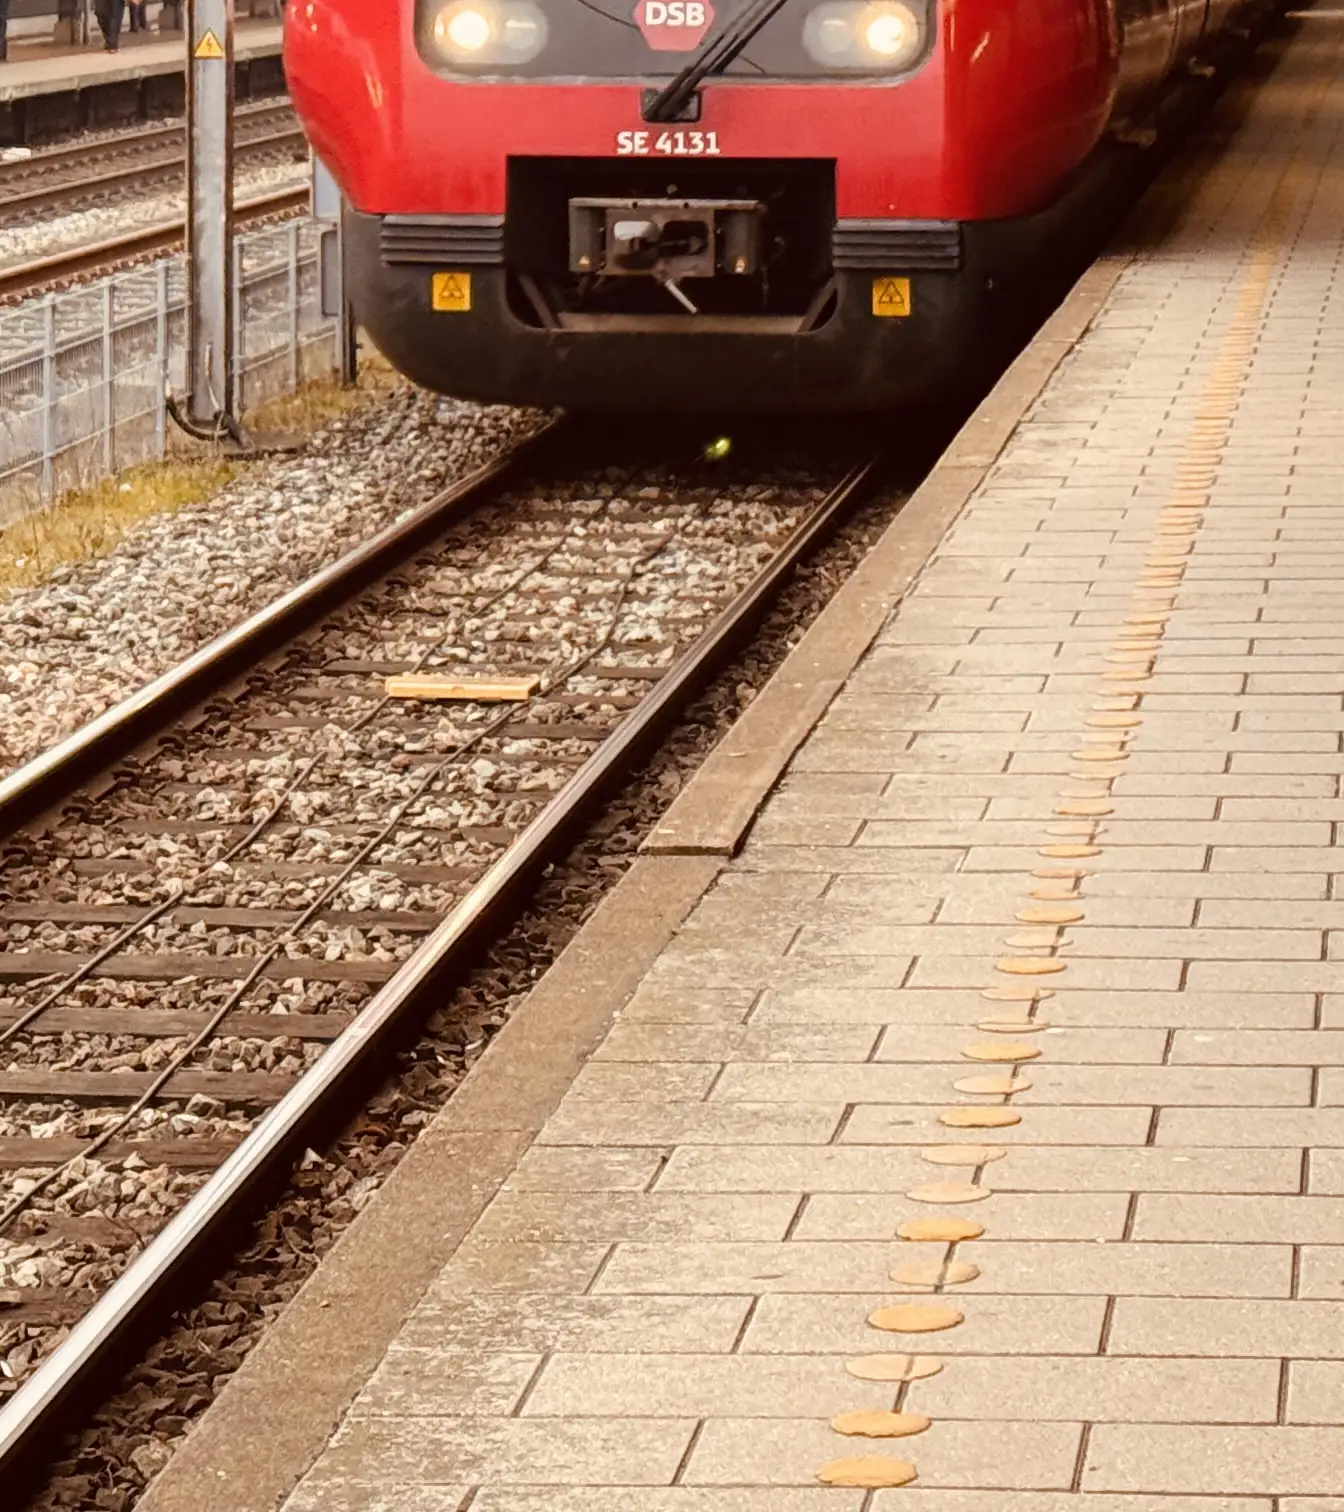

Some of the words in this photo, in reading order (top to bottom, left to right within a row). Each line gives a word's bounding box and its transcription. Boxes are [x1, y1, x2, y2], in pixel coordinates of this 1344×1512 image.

[645, 1, 705, 26] DSB
[616, 131, 649, 154] SE
[655, 131, 721, 155] 4131
